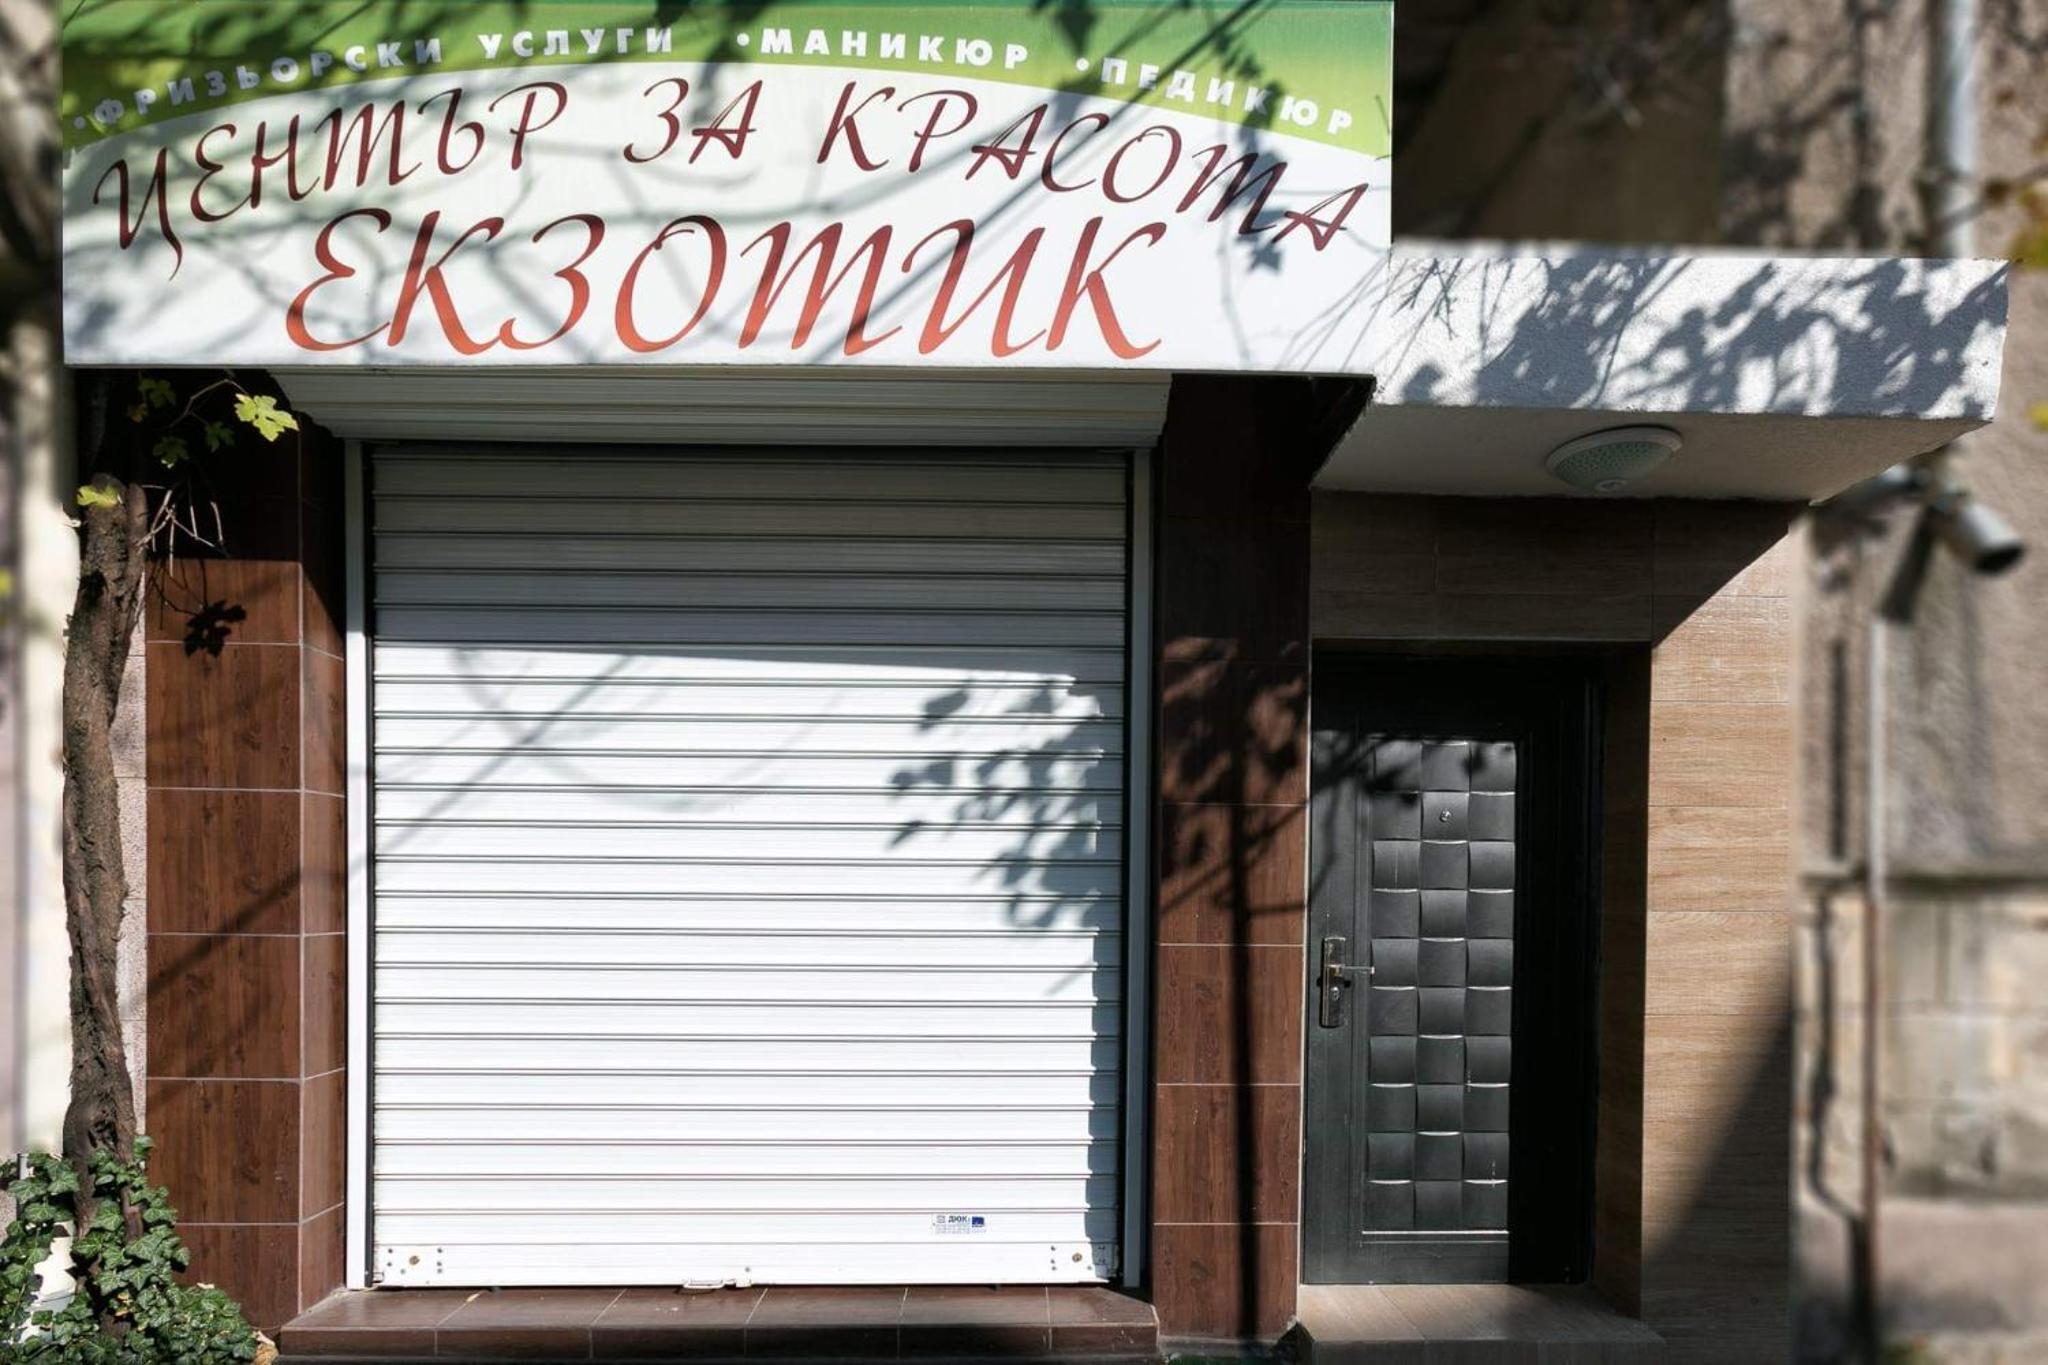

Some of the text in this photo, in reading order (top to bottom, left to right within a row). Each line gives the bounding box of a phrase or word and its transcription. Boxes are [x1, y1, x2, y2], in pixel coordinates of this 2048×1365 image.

[94, 26, 1354, 136] ФРИЗЬОРСКИ УСЛУГИ МАНИКЮР ПЕДИКЮР
[92, 77, 1370, 282] ЦЕНТЪР ЗА КРАСОТА
[285, 207, 1168, 360] ЕКЗОТИК
